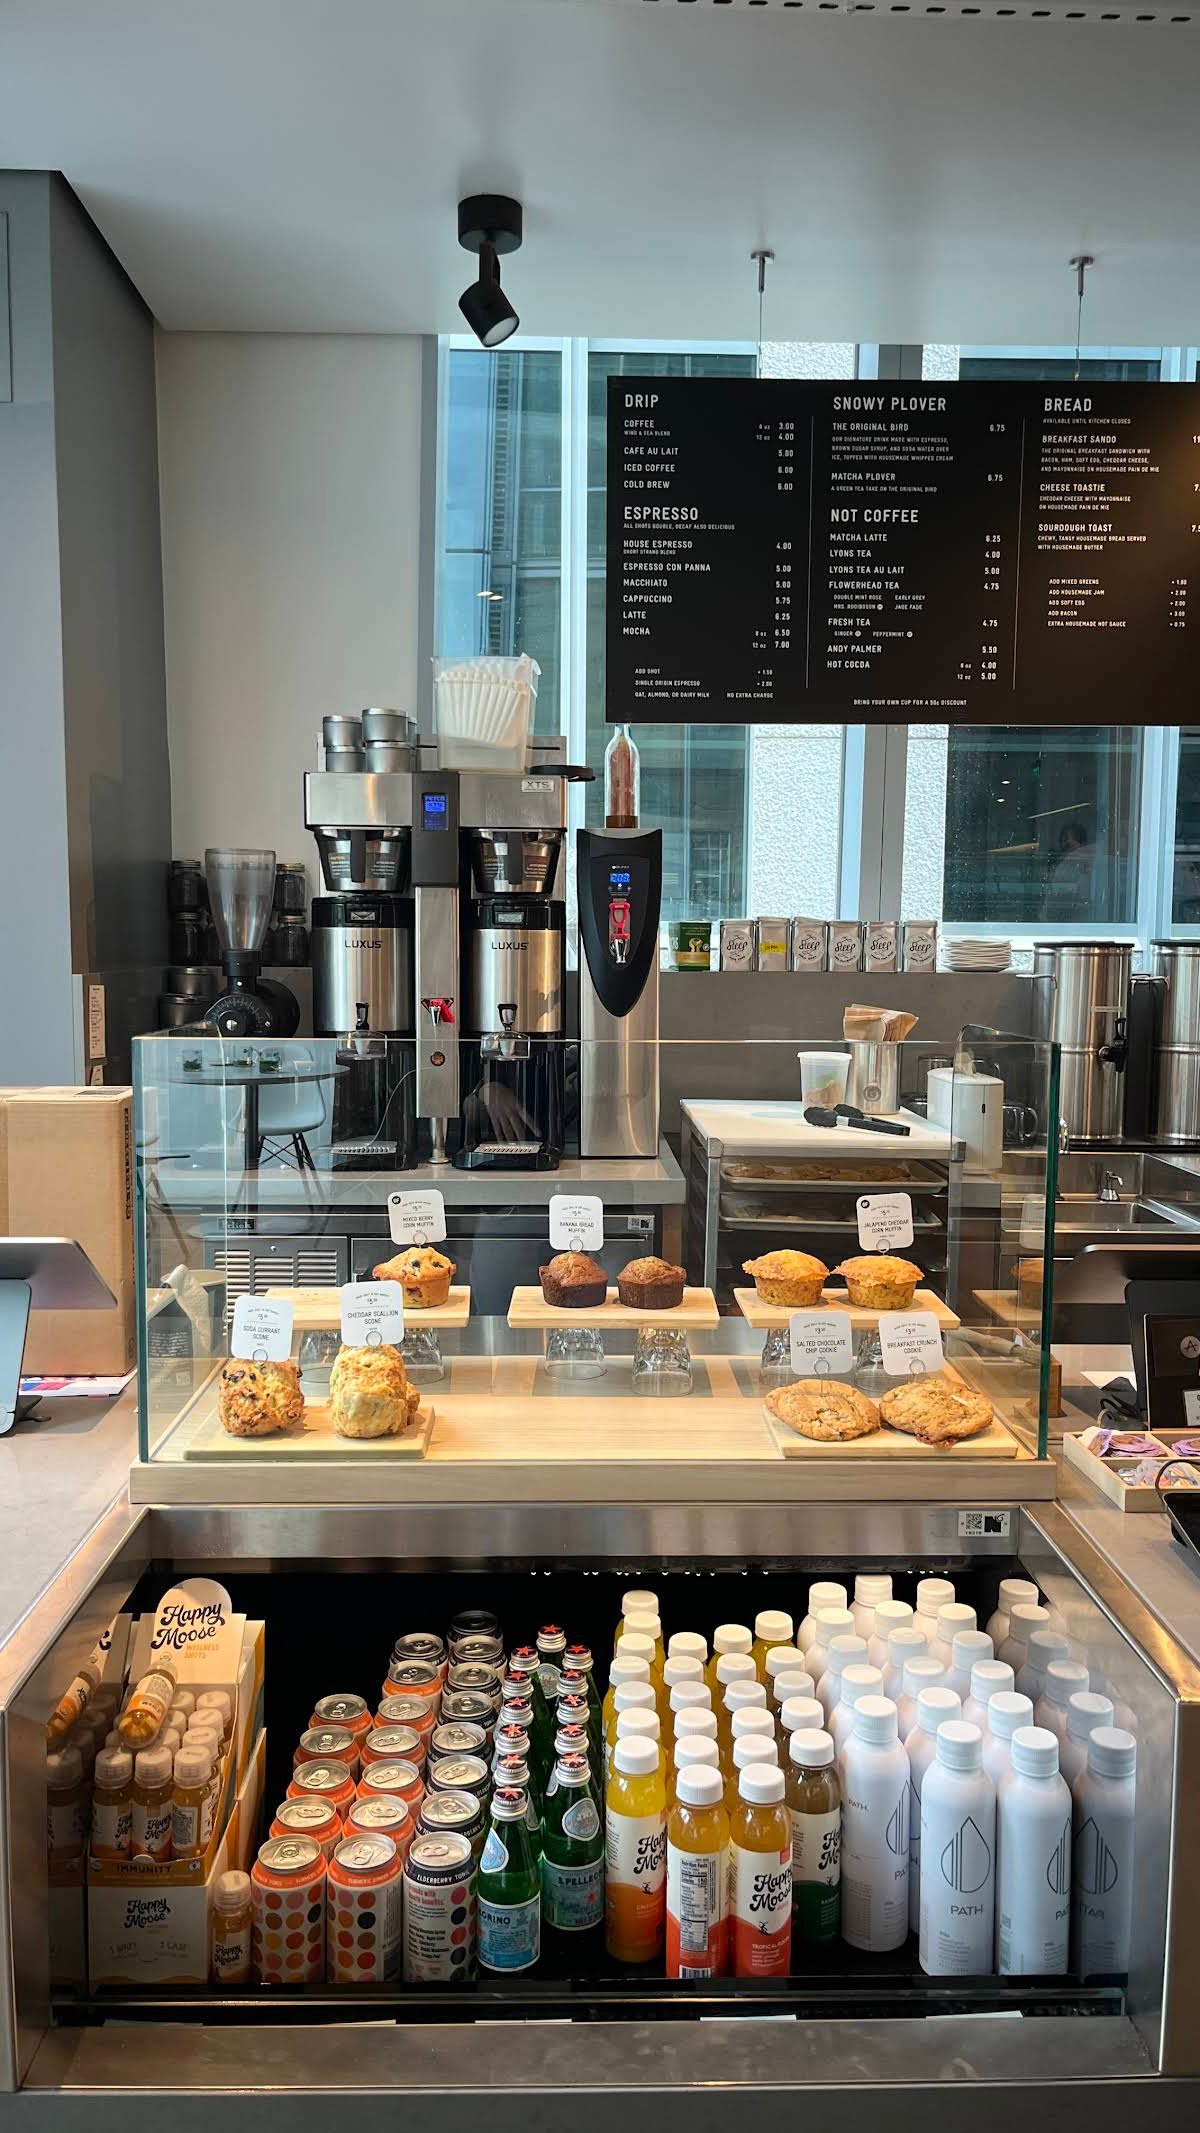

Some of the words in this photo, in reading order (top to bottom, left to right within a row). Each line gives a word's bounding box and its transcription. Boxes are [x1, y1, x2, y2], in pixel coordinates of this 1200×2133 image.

[624, 394, 659, 408] DRIP
[833, 397, 885, 410] SNOWY
[891, 397, 946, 411] PLOVER
[1044, 398, 1092, 411] BREAD
[624, 506, 698, 520] ESPRESSO
[831, 509, 858, 522] NOT
[864, 510, 919, 523] COFFEE
[527, 781, 550, 789] XTS
[344, 939, 383, 950] LUXUS
[491, 941, 529, 951] LUXUS
[887, 1341, 914, 1349] BREAKFAST
[916, 1340, 938, 1348] CRUNCH
[160, 1604, 226, 1628] Happy
[150, 1626, 216, 1650] Moose
[638, 1824, 667, 1855] Hap
[633, 1849, 667, 1874] Moo
[118, 1865, 172, 1873] IMMUNITY
[416, 1874, 452, 1884] ELDERBERRY
[127, 1898, 171, 1914] Happy
[950, 1904, 984, 1916] PATH
[124, 1912, 166, 1928] Moose
[215, 1944, 243, 1955] Happy
[214, 1953, 240, 1966] Moose
